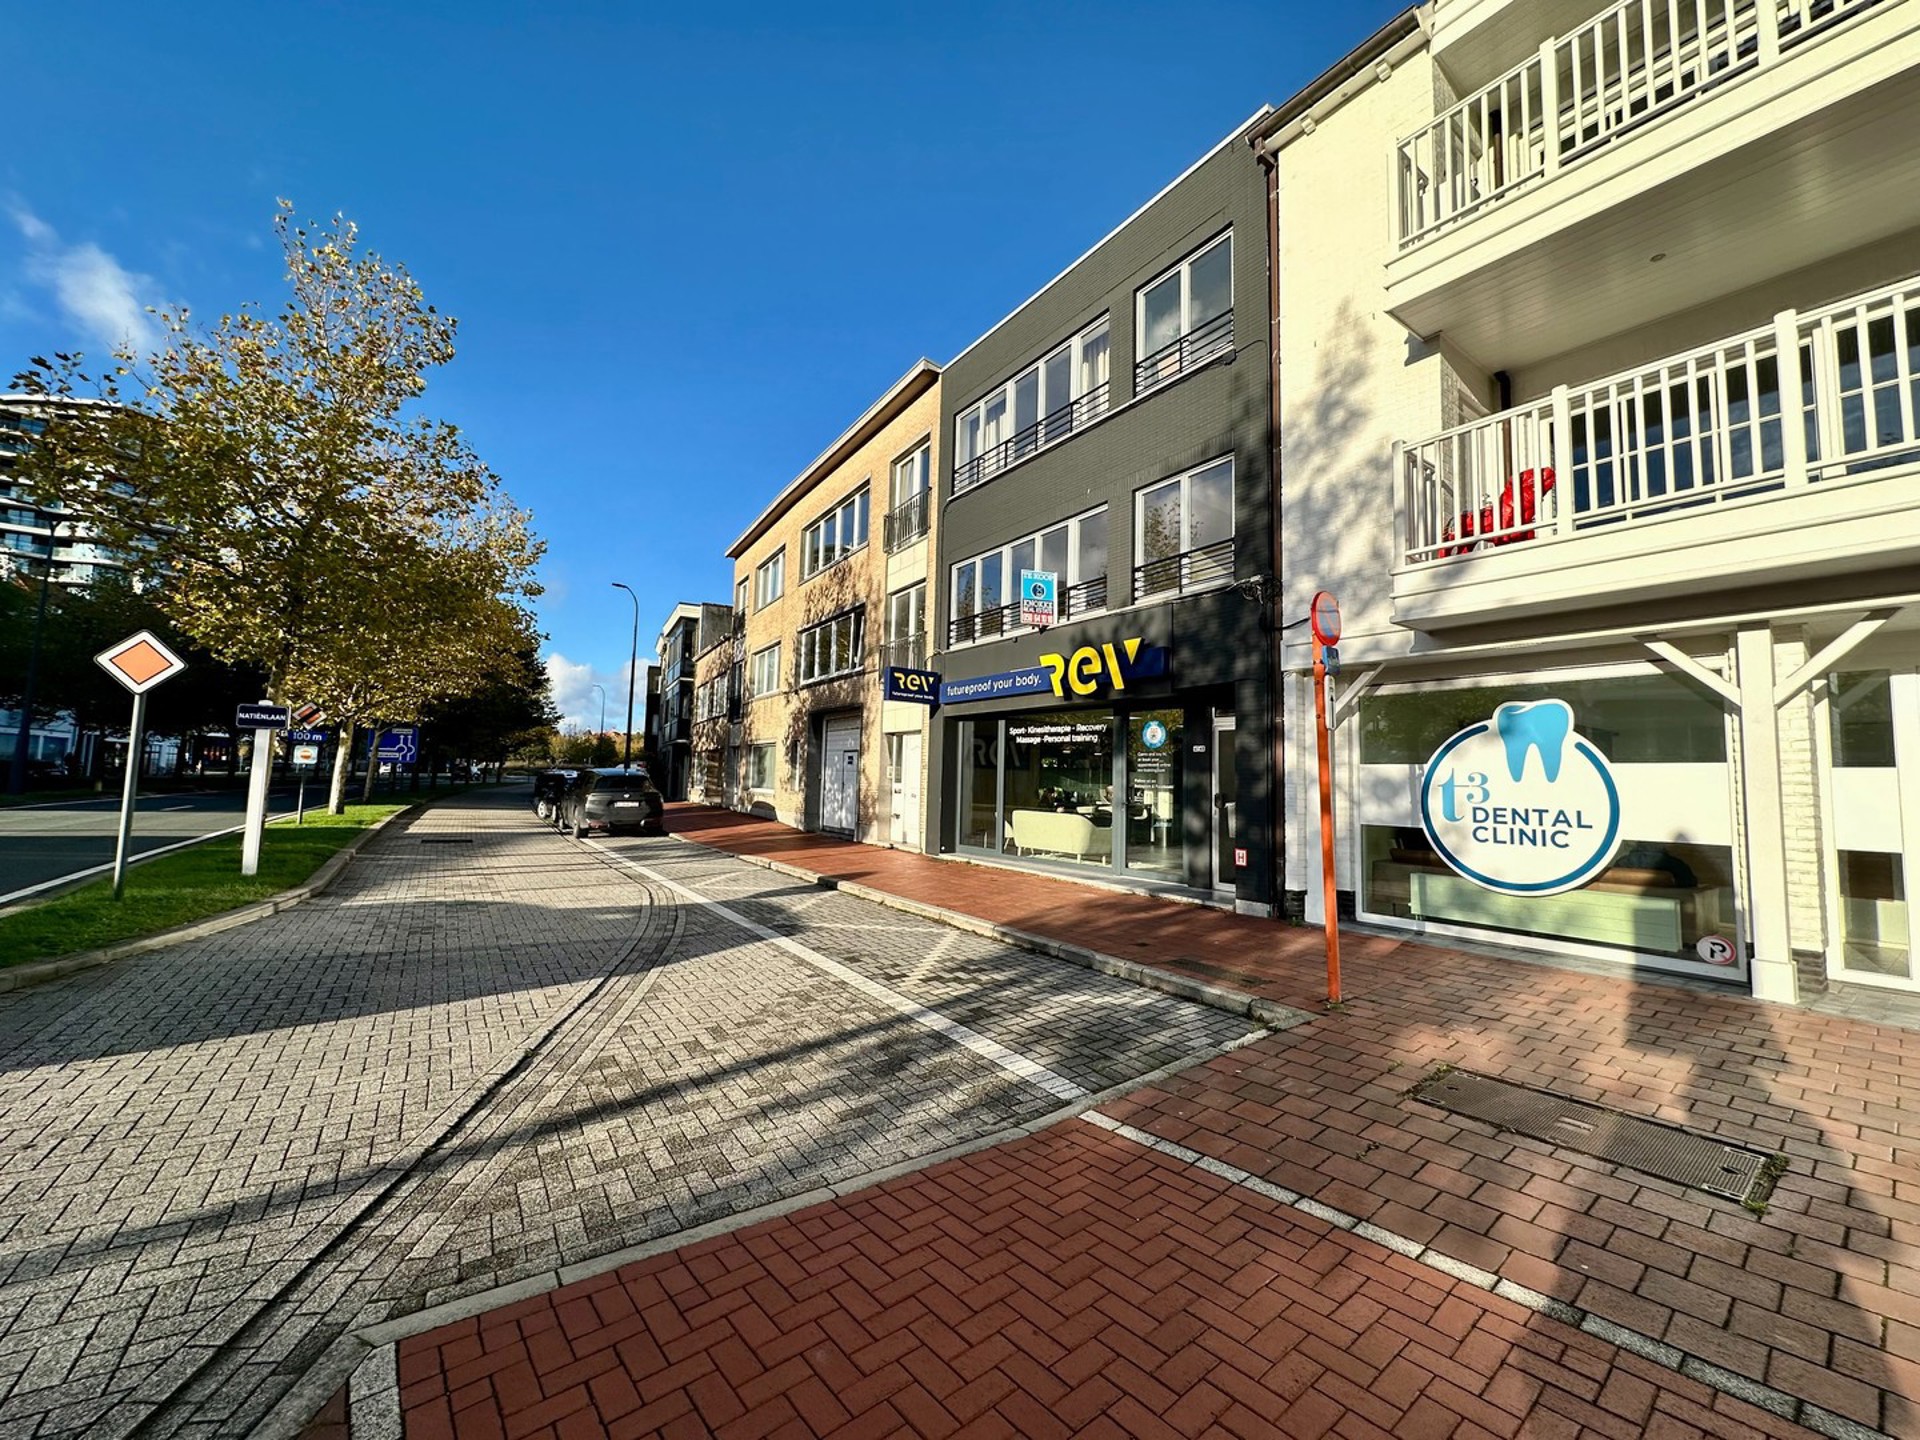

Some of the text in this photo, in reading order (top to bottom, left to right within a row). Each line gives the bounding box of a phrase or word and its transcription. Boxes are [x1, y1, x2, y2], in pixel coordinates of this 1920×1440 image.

[947, 673, 1042, 697] futureproof your body.
[1076, 723, 1107, 733] Recovery
[293, 732, 310, 741] 100
[1016, 736, 1041, 745] Massage
[1071, 734, 1098, 744] training
[1472, 807, 1593, 829] DENTAL
[1472, 826, 1570, 848] CLINIC
